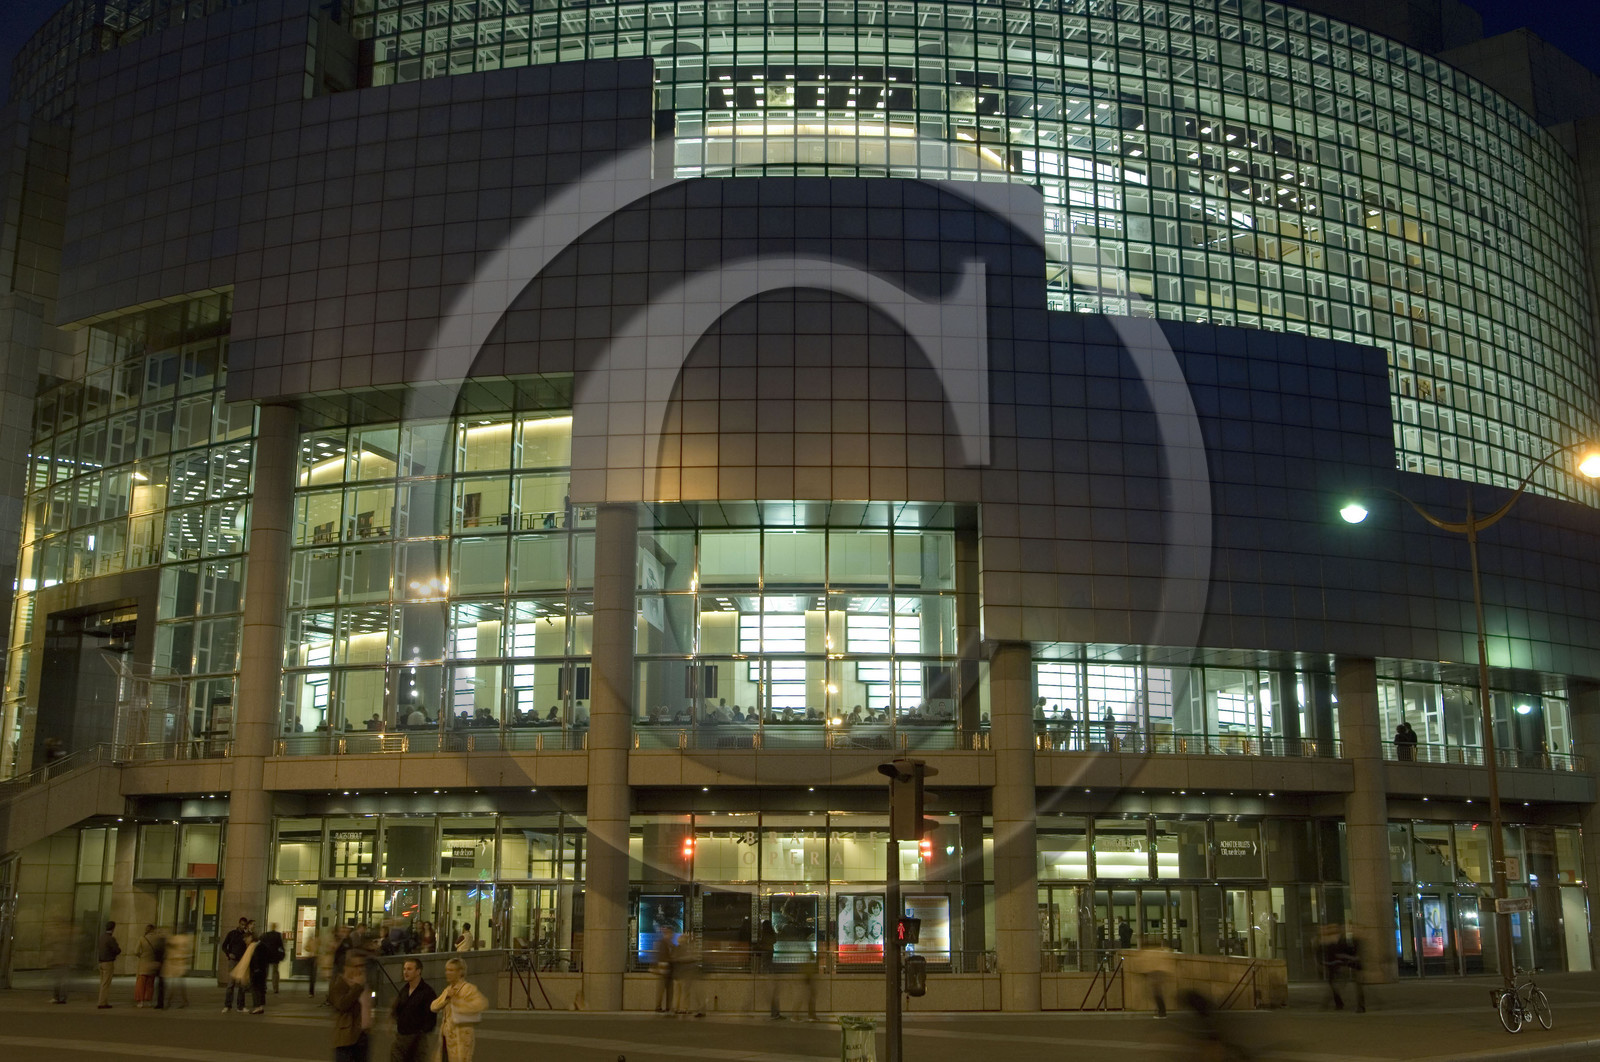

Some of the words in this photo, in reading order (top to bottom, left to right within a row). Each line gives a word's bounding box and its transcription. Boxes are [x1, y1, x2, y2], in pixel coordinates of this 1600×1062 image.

[709, 831, 878, 845] LIBRAIRIE
[1220, 840, 1233, 848] ACHAT
[1238, 840, 1251, 848] BILLETS
[464, 849, 473, 858] Lyon
[743, 852, 843, 865] OPERA
